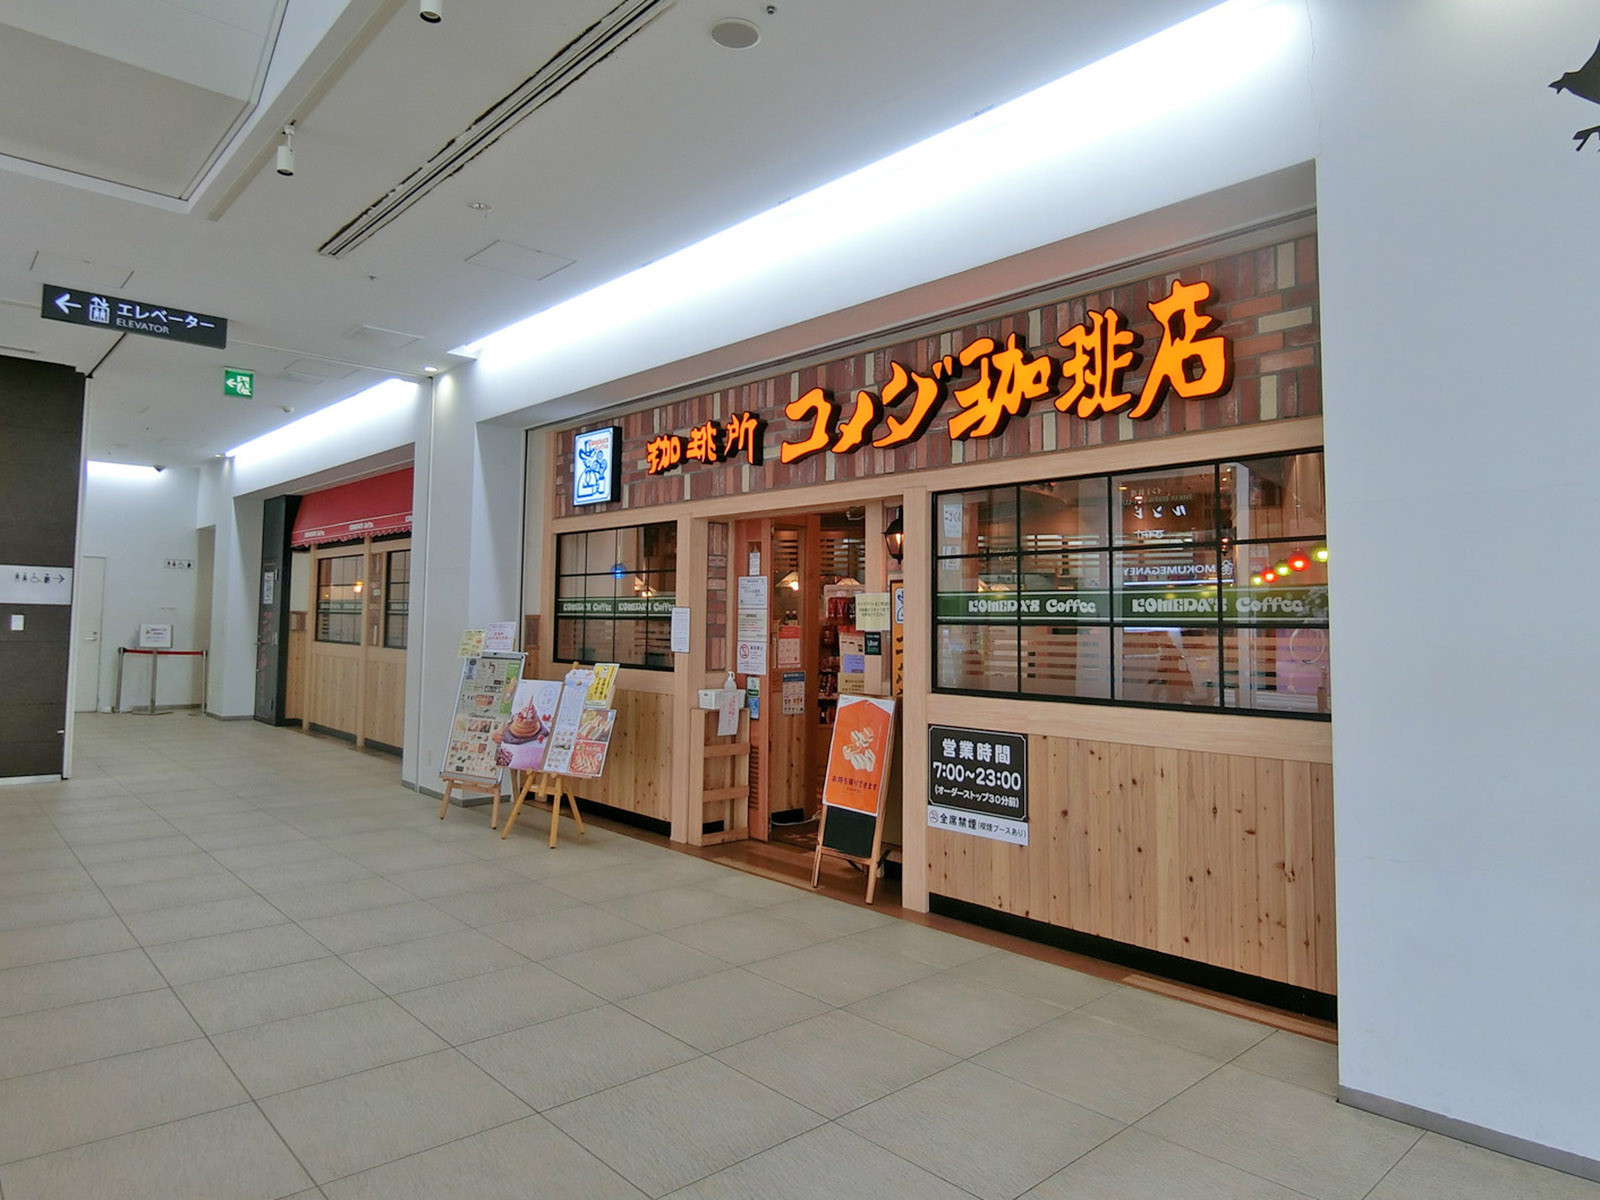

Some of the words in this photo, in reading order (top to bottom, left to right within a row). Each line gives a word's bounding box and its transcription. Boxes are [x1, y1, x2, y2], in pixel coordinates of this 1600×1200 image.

[116, 318, 170, 334] ELEVATOR
[117, 303, 215, 328] エレベーター
[646, 412, 758, 474] 珈琲所
[780, 279, 1226, 463] コメダ珈琲店
[1045, 599, 1096, 613] Coffee
[1235, 596, 1304, 613] Coffee
[942, 738, 1011, 765] 営業時間
